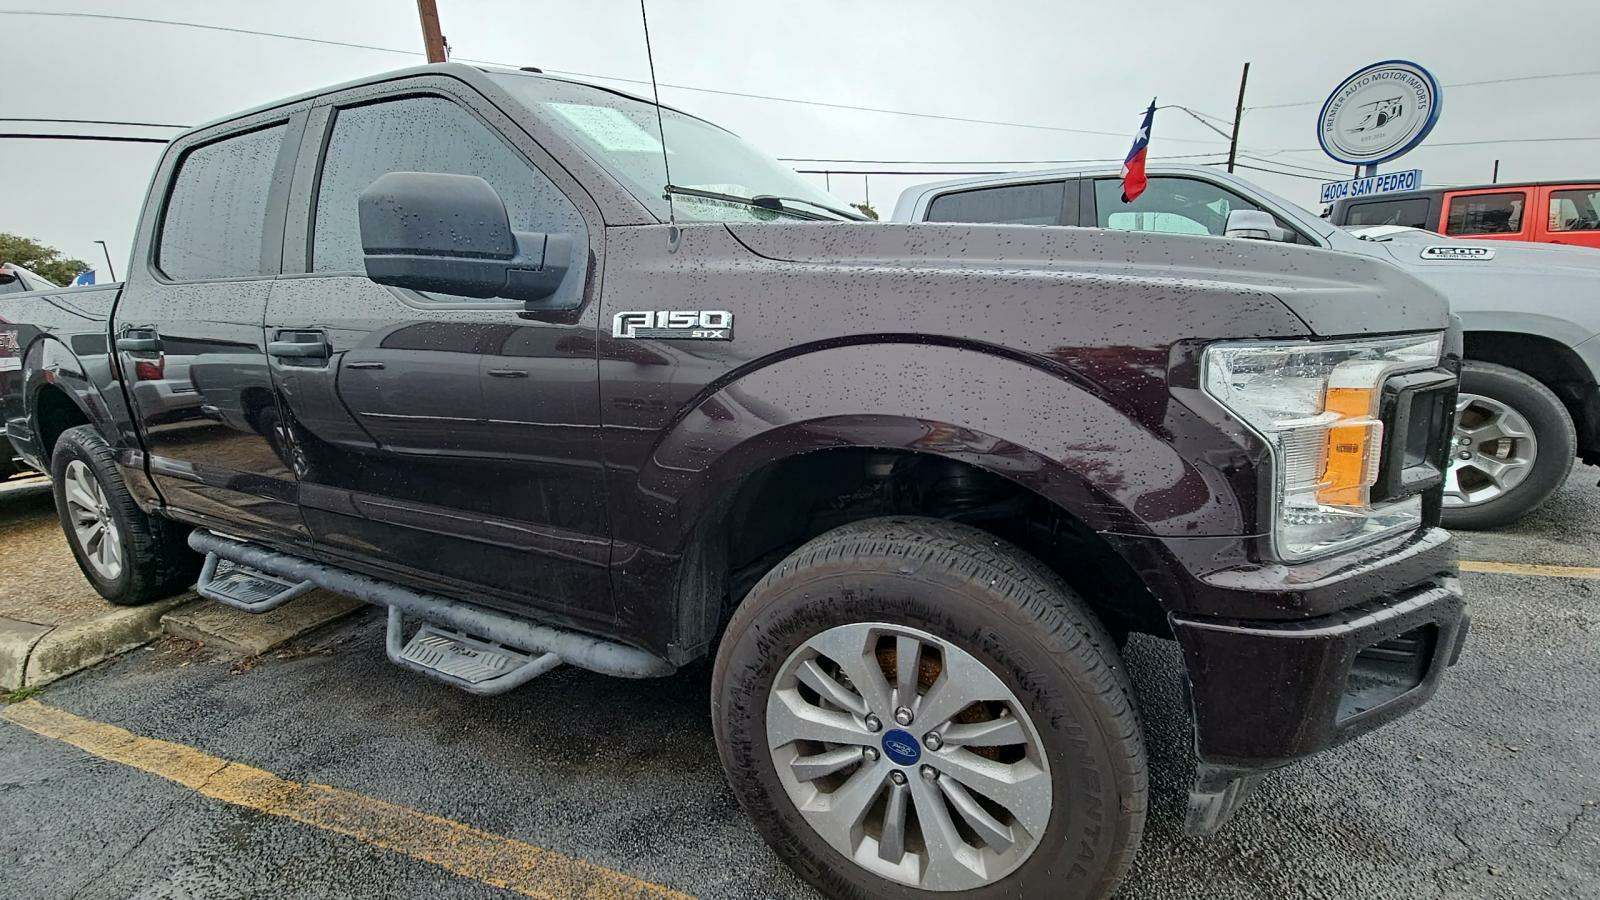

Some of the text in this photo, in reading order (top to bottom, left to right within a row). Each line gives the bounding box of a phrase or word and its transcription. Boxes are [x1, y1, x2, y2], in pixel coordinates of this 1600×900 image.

[1326, 72, 1427, 132] PREMIER AUTO MOTOR IMPORTS
[1323, 172, 1414, 200] 4004 SAN PEDRO
[692, 330, 723, 338] STX
